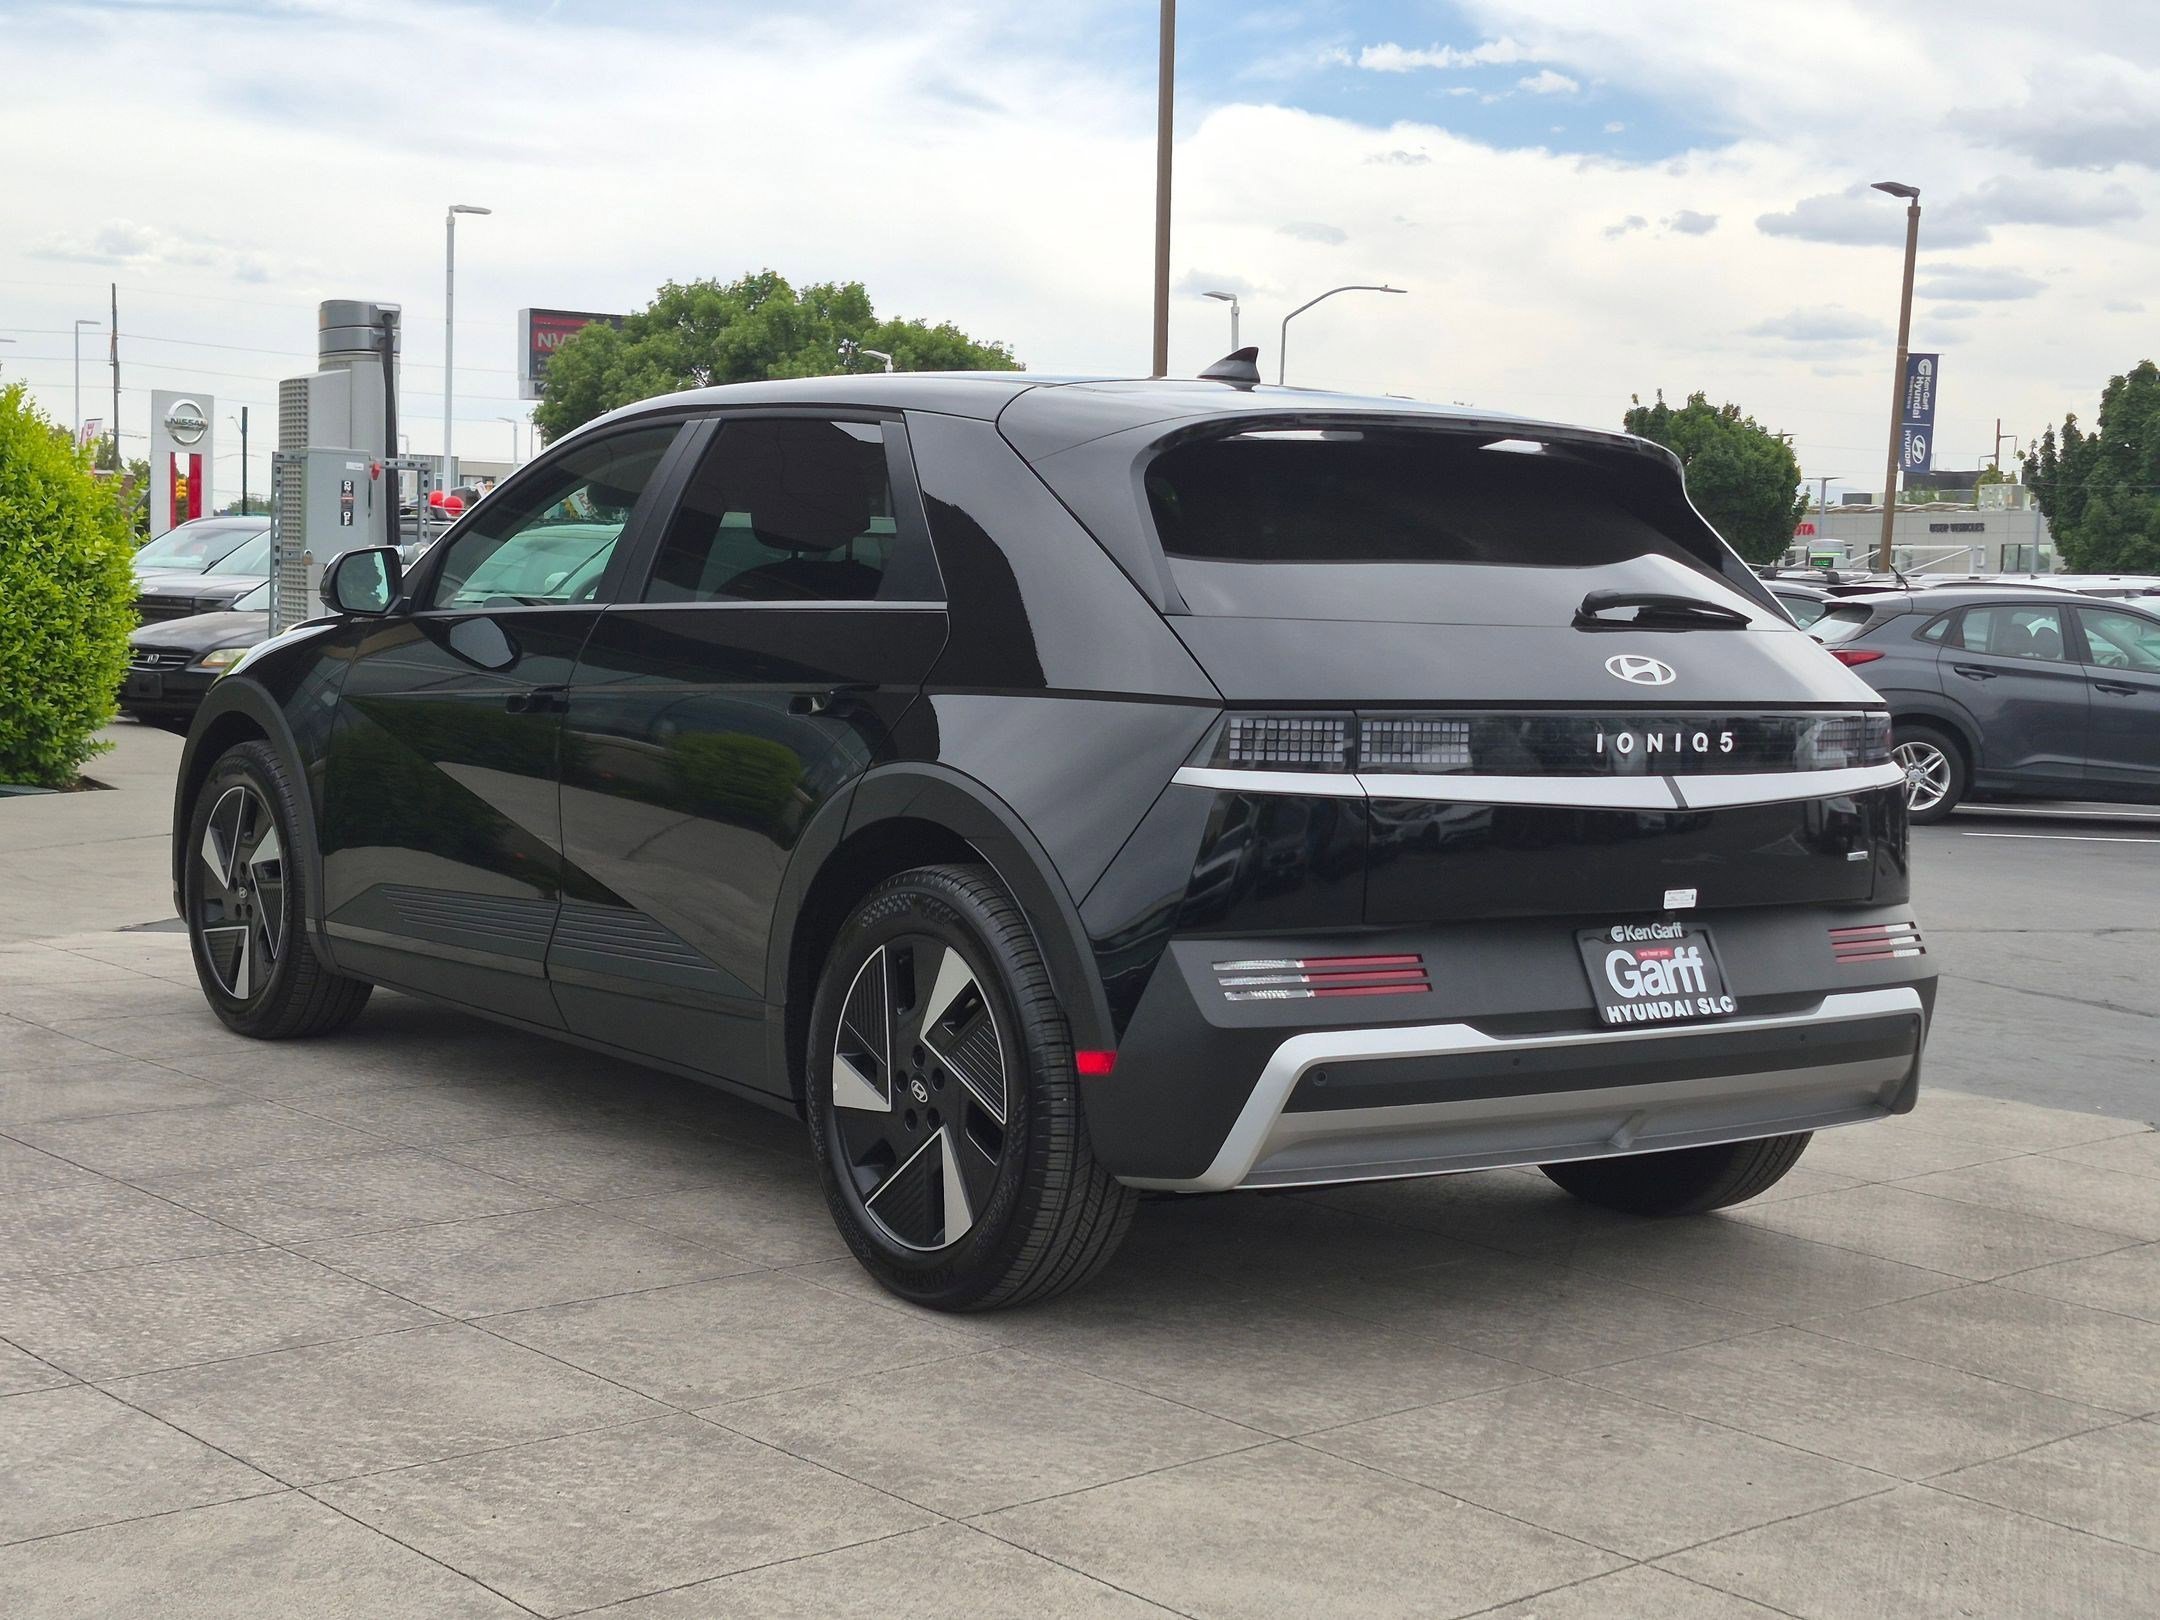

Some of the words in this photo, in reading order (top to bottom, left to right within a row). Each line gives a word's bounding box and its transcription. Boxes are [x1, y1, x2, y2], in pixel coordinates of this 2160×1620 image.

[1912, 376, 1922, 419] Hyundai
[170, 417, 208, 428] NISSAN
[1950, 522, 1985, 532] VEHICLES
[1605, 946, 1707, 998] Garff
[1606, 999, 1694, 1023] HYUNDAI
[1697, 995, 1734, 1015] SLC
